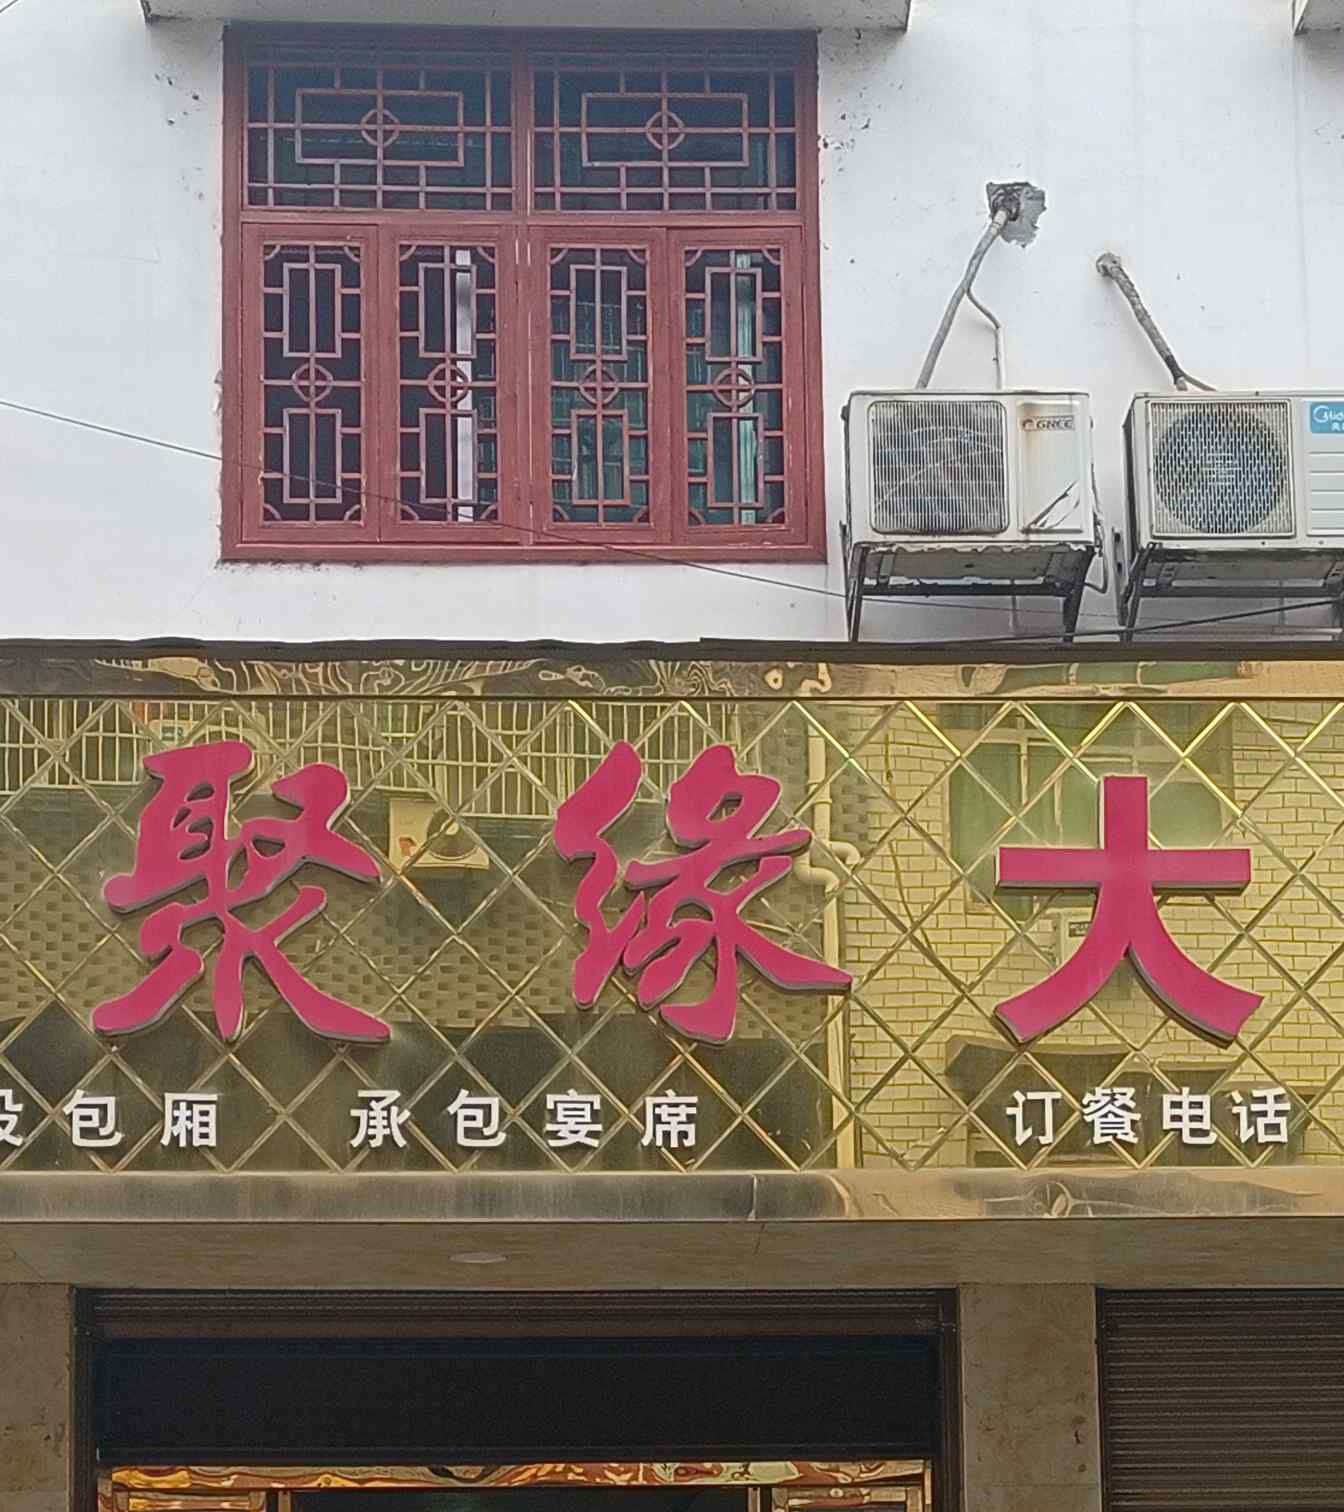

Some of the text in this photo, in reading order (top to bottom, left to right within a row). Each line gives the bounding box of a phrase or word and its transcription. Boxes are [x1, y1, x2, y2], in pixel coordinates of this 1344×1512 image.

[349, 1088, 700, 1148] 承包宴席
[1005, 1086, 1292, 1146] 订餐电话
